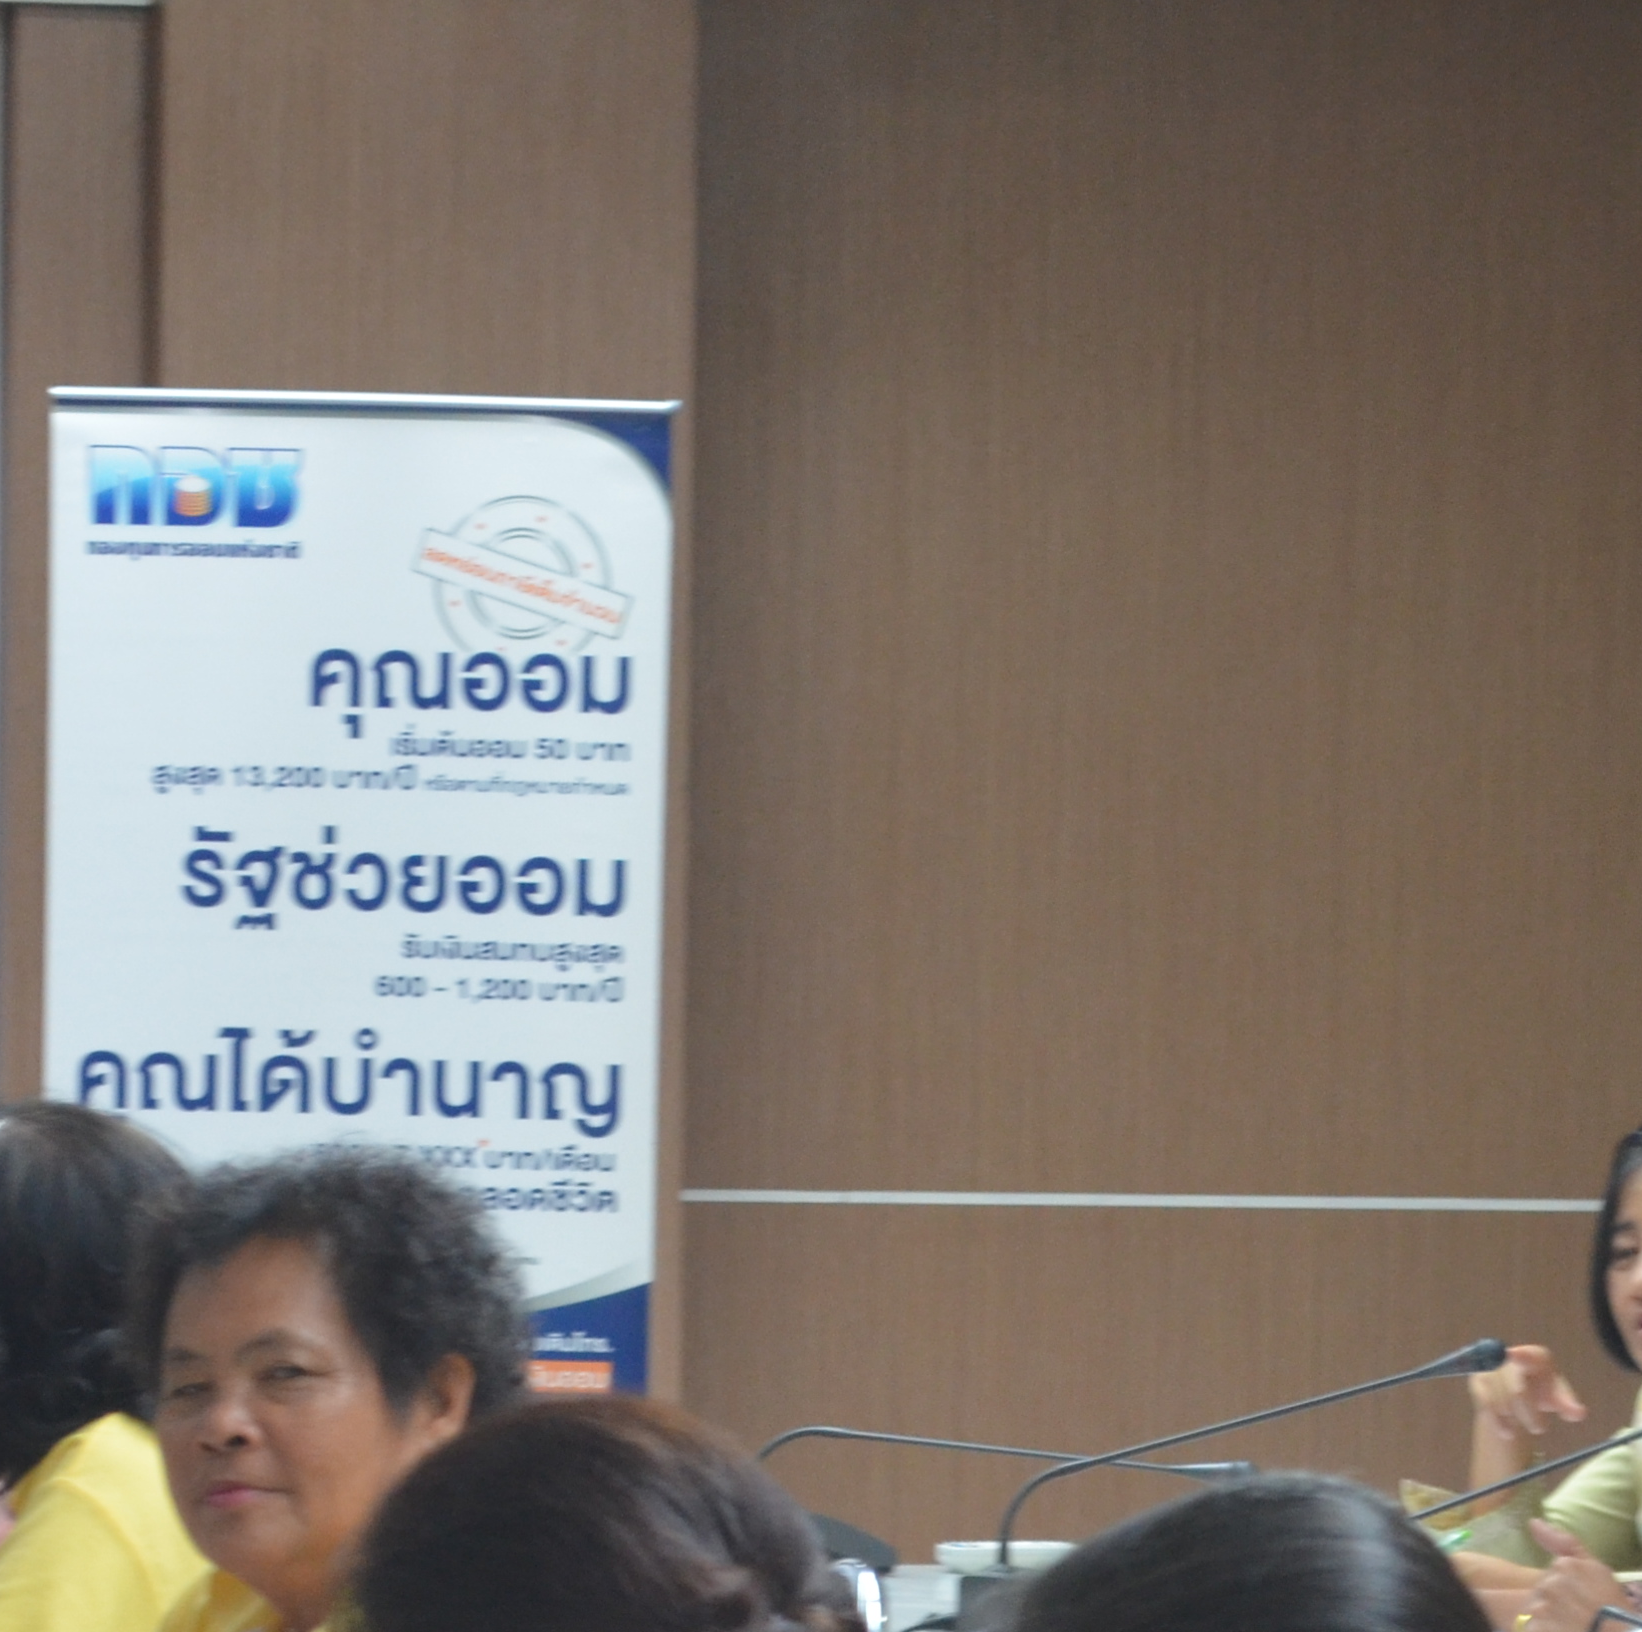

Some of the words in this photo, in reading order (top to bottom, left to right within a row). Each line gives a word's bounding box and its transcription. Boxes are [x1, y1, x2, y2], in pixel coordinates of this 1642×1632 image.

[308, 647, 634, 739] คุณออม
[232, 766, 325, 792] 13,200
[534, 738, 568, 760] 50
[576, 740, 632, 762] บาท
[180, 824, 629, 931] รัฐช่วยออม
[375, 975, 426, 998] 600
[456, 977, 532, 1003] 1,200
[79, 1027, 622, 1138] คณได้บำนาญ
